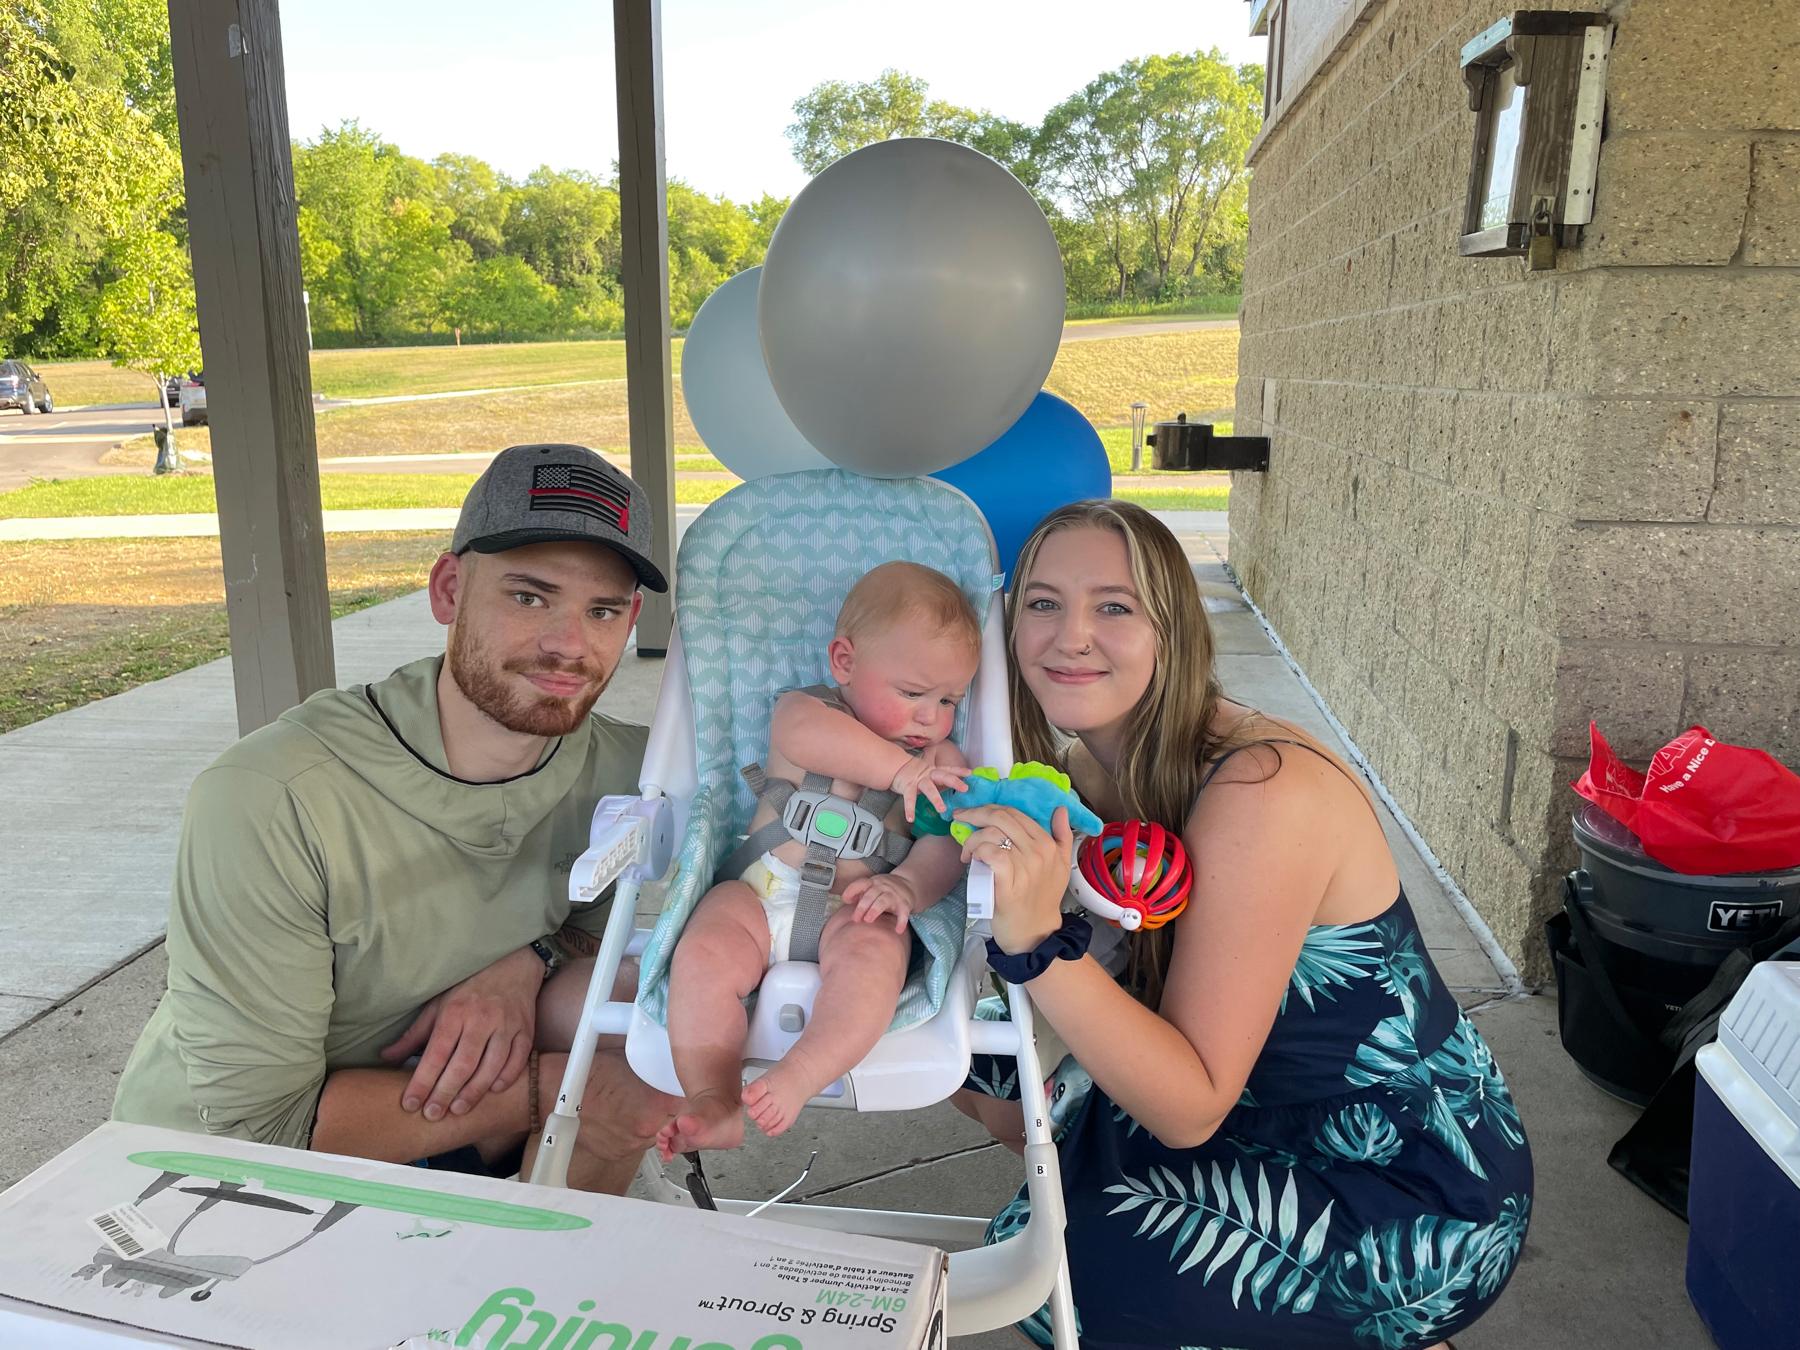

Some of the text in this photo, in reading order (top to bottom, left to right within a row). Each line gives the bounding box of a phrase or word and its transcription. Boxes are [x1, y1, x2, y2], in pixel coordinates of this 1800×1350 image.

[1686, 747, 1709, 773] Nice
[1682, 772, 1692, 782] a
[1659, 779, 1685, 794] Have
[559, 1093, 566, 1103] A
[1036, 1118, 1043, 1128] B
[545, 1135, 553, 1145] A
[1037, 1165, 1044, 1175] B
[779, 1265, 828, 1276] actividades
[842, 1264, 866, 1274] table
[878, 1269, 915, 1279] Sauteur
[777, 1273, 800, 1283] Table
[809, 1277, 844, 1287] Jumper
[841, 1273, 865, 1281] mesa
[873, 1276, 912, 1287] Brincolin
[845, 1280, 880, 1292] Activity
[881, 1285, 909, 1294] 2-in-1
[815, 1289, 907, 1313] 6M-24M
[800, 1308, 817, 1325] &
[821, 1307, 897, 1334] Spring
